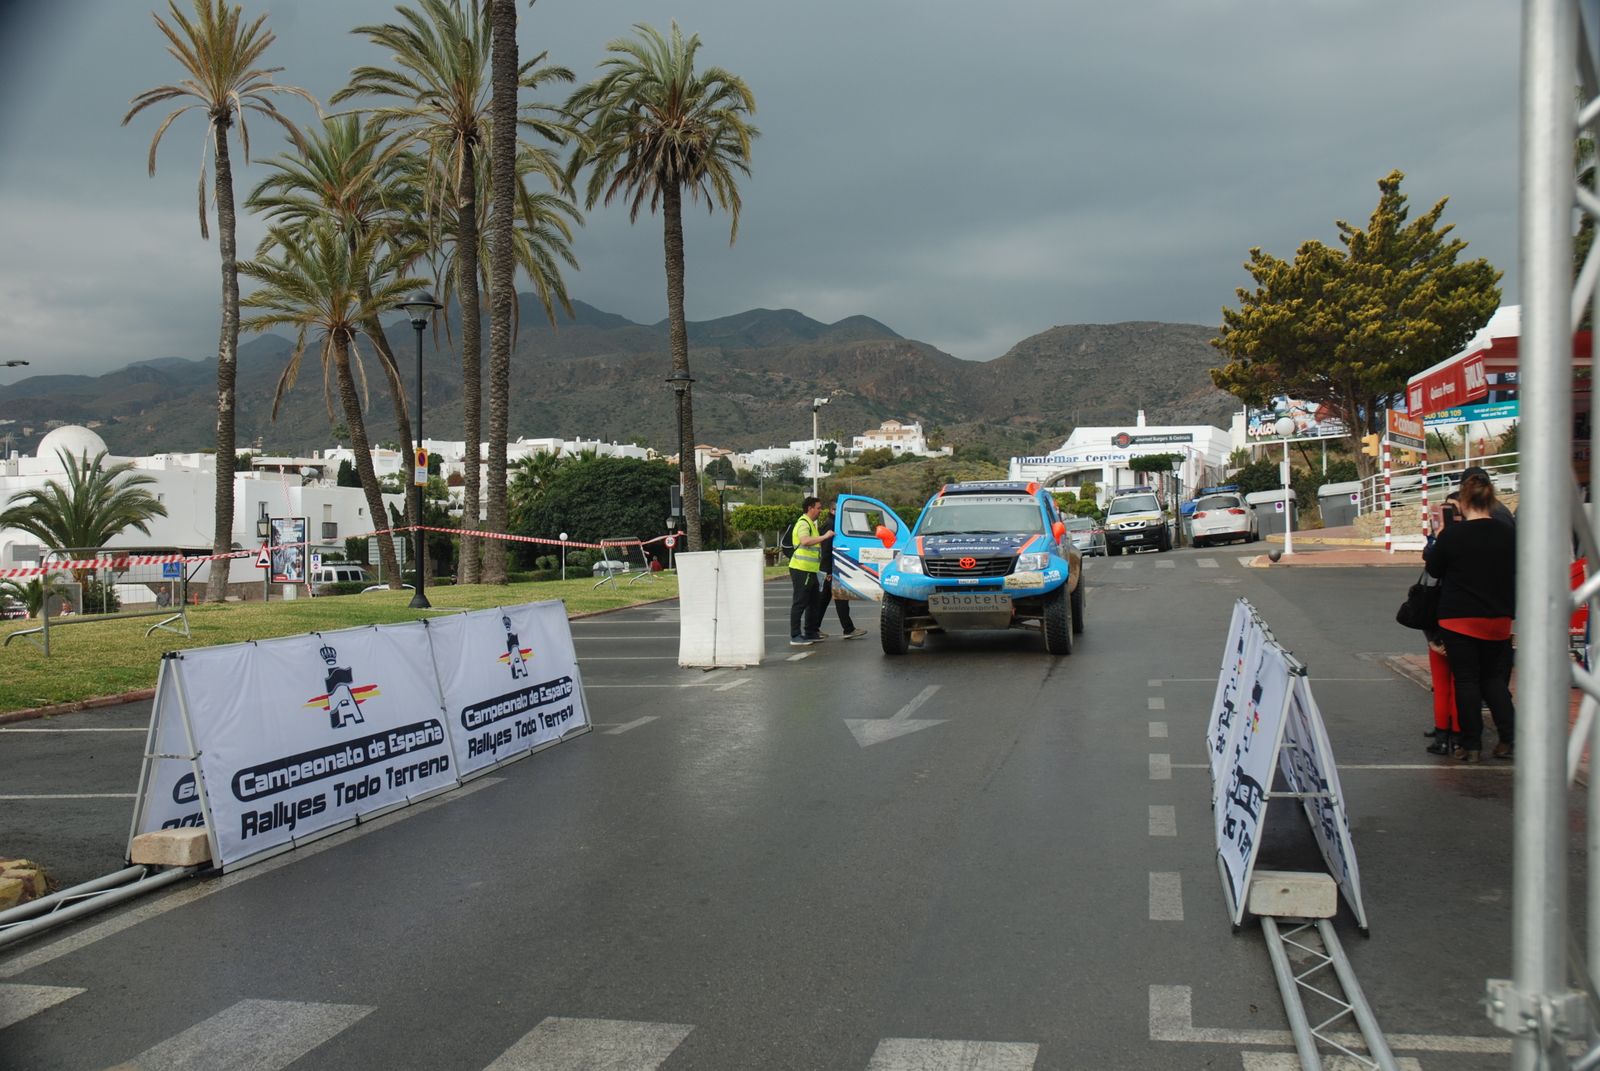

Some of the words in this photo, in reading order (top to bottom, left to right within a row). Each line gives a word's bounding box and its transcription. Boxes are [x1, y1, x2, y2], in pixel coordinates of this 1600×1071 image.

[1085, 453, 1127, 463] Centro
[931, 594, 1008, 606] sbhotels
[529, 690, 540, 705] de
[468, 727, 512, 759] Rallyes
[239, 747, 364, 798] Campeonato
[368, 739, 386, 760] de
[389, 722, 443, 753] España
[241, 793, 327, 841] Rallyes
[334, 774, 381, 807] Todo
[385, 754, 449, 790] Terreno
